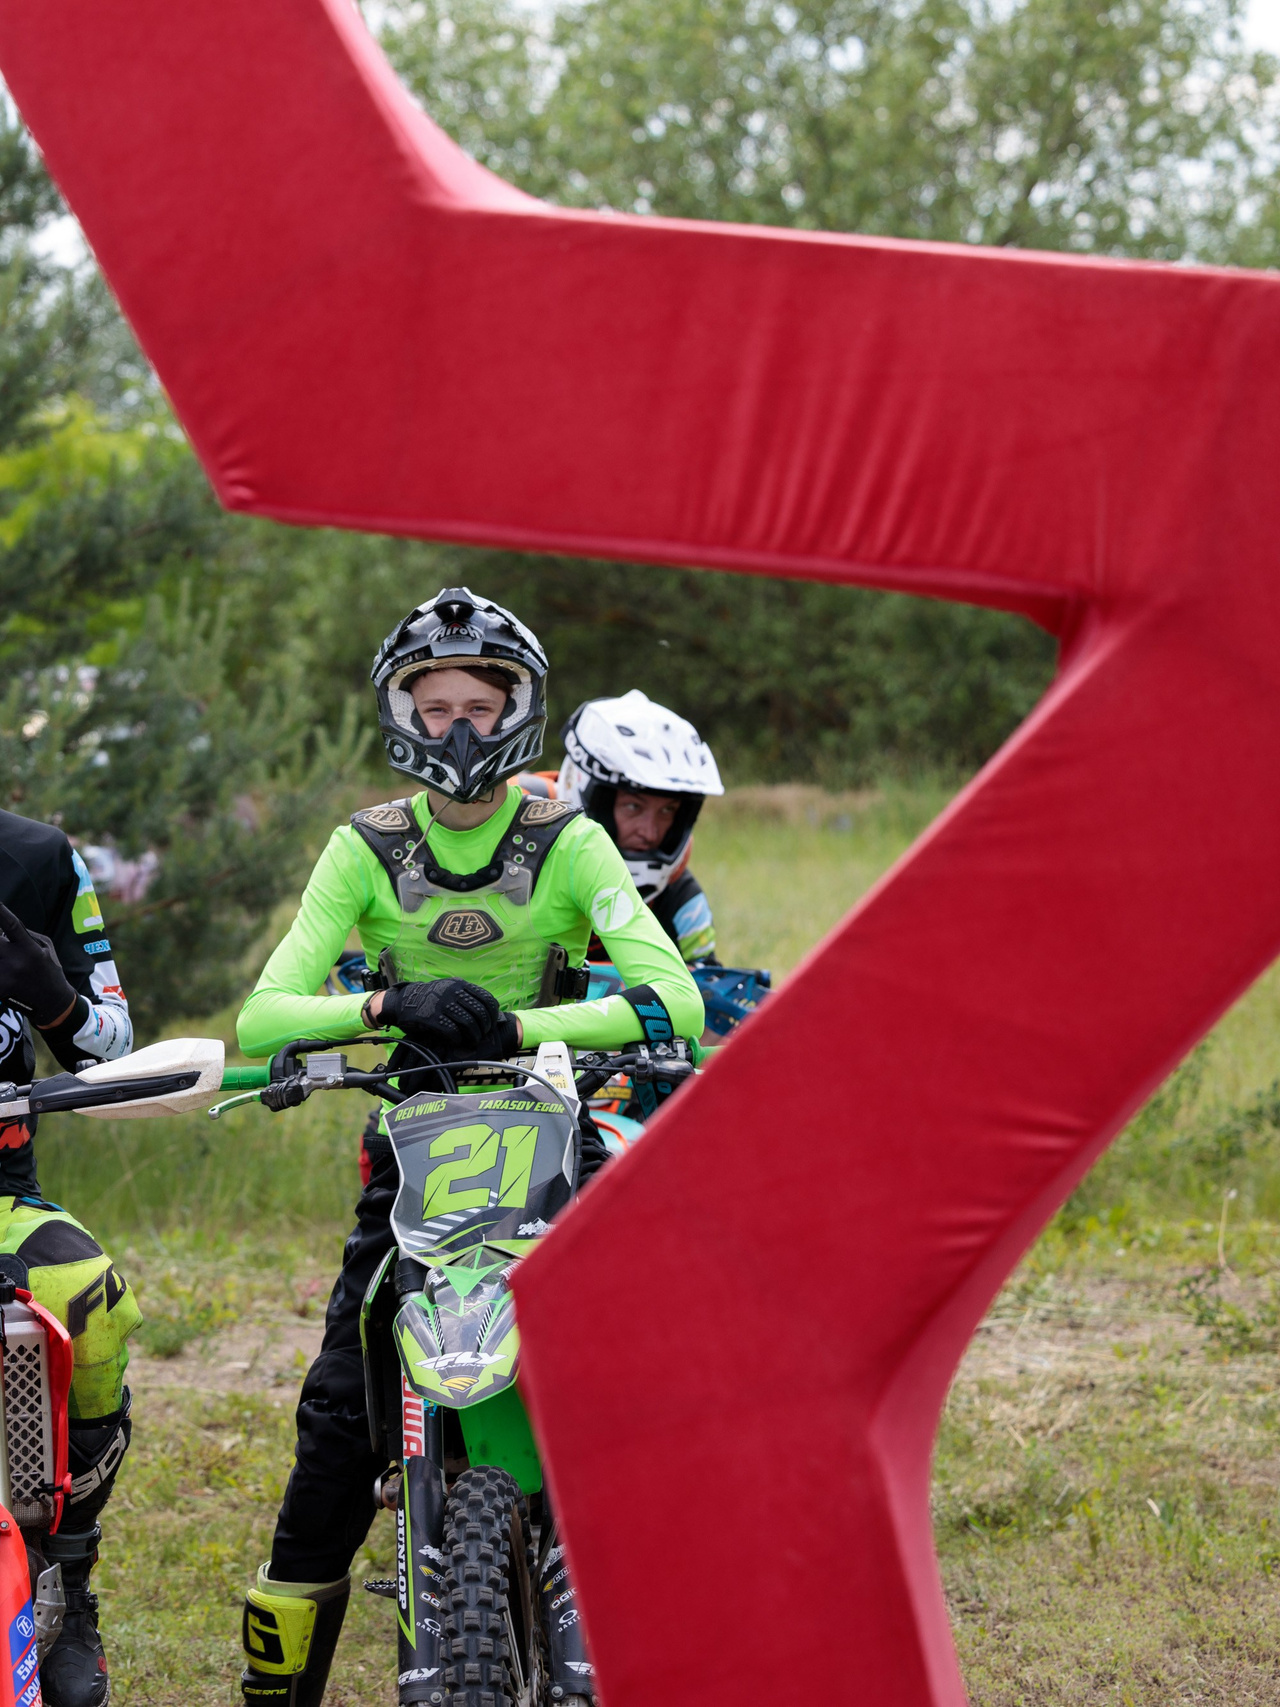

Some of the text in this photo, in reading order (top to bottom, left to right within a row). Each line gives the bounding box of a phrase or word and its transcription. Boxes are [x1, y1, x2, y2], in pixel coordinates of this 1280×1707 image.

[434, 626, 483, 642] Airoh
[394, 1098, 448, 1122] RED WINGS
[477, 1099, 535, 1113] TARASOV
[422, 1122, 540, 1221] 21
[397, 1508, 407, 1610] DUNLOP
[415, 1621, 445, 1641] OAKLE
[557, 1613, 584, 1633] OAKLE
[16, 1642, 39, 1682] SKF
